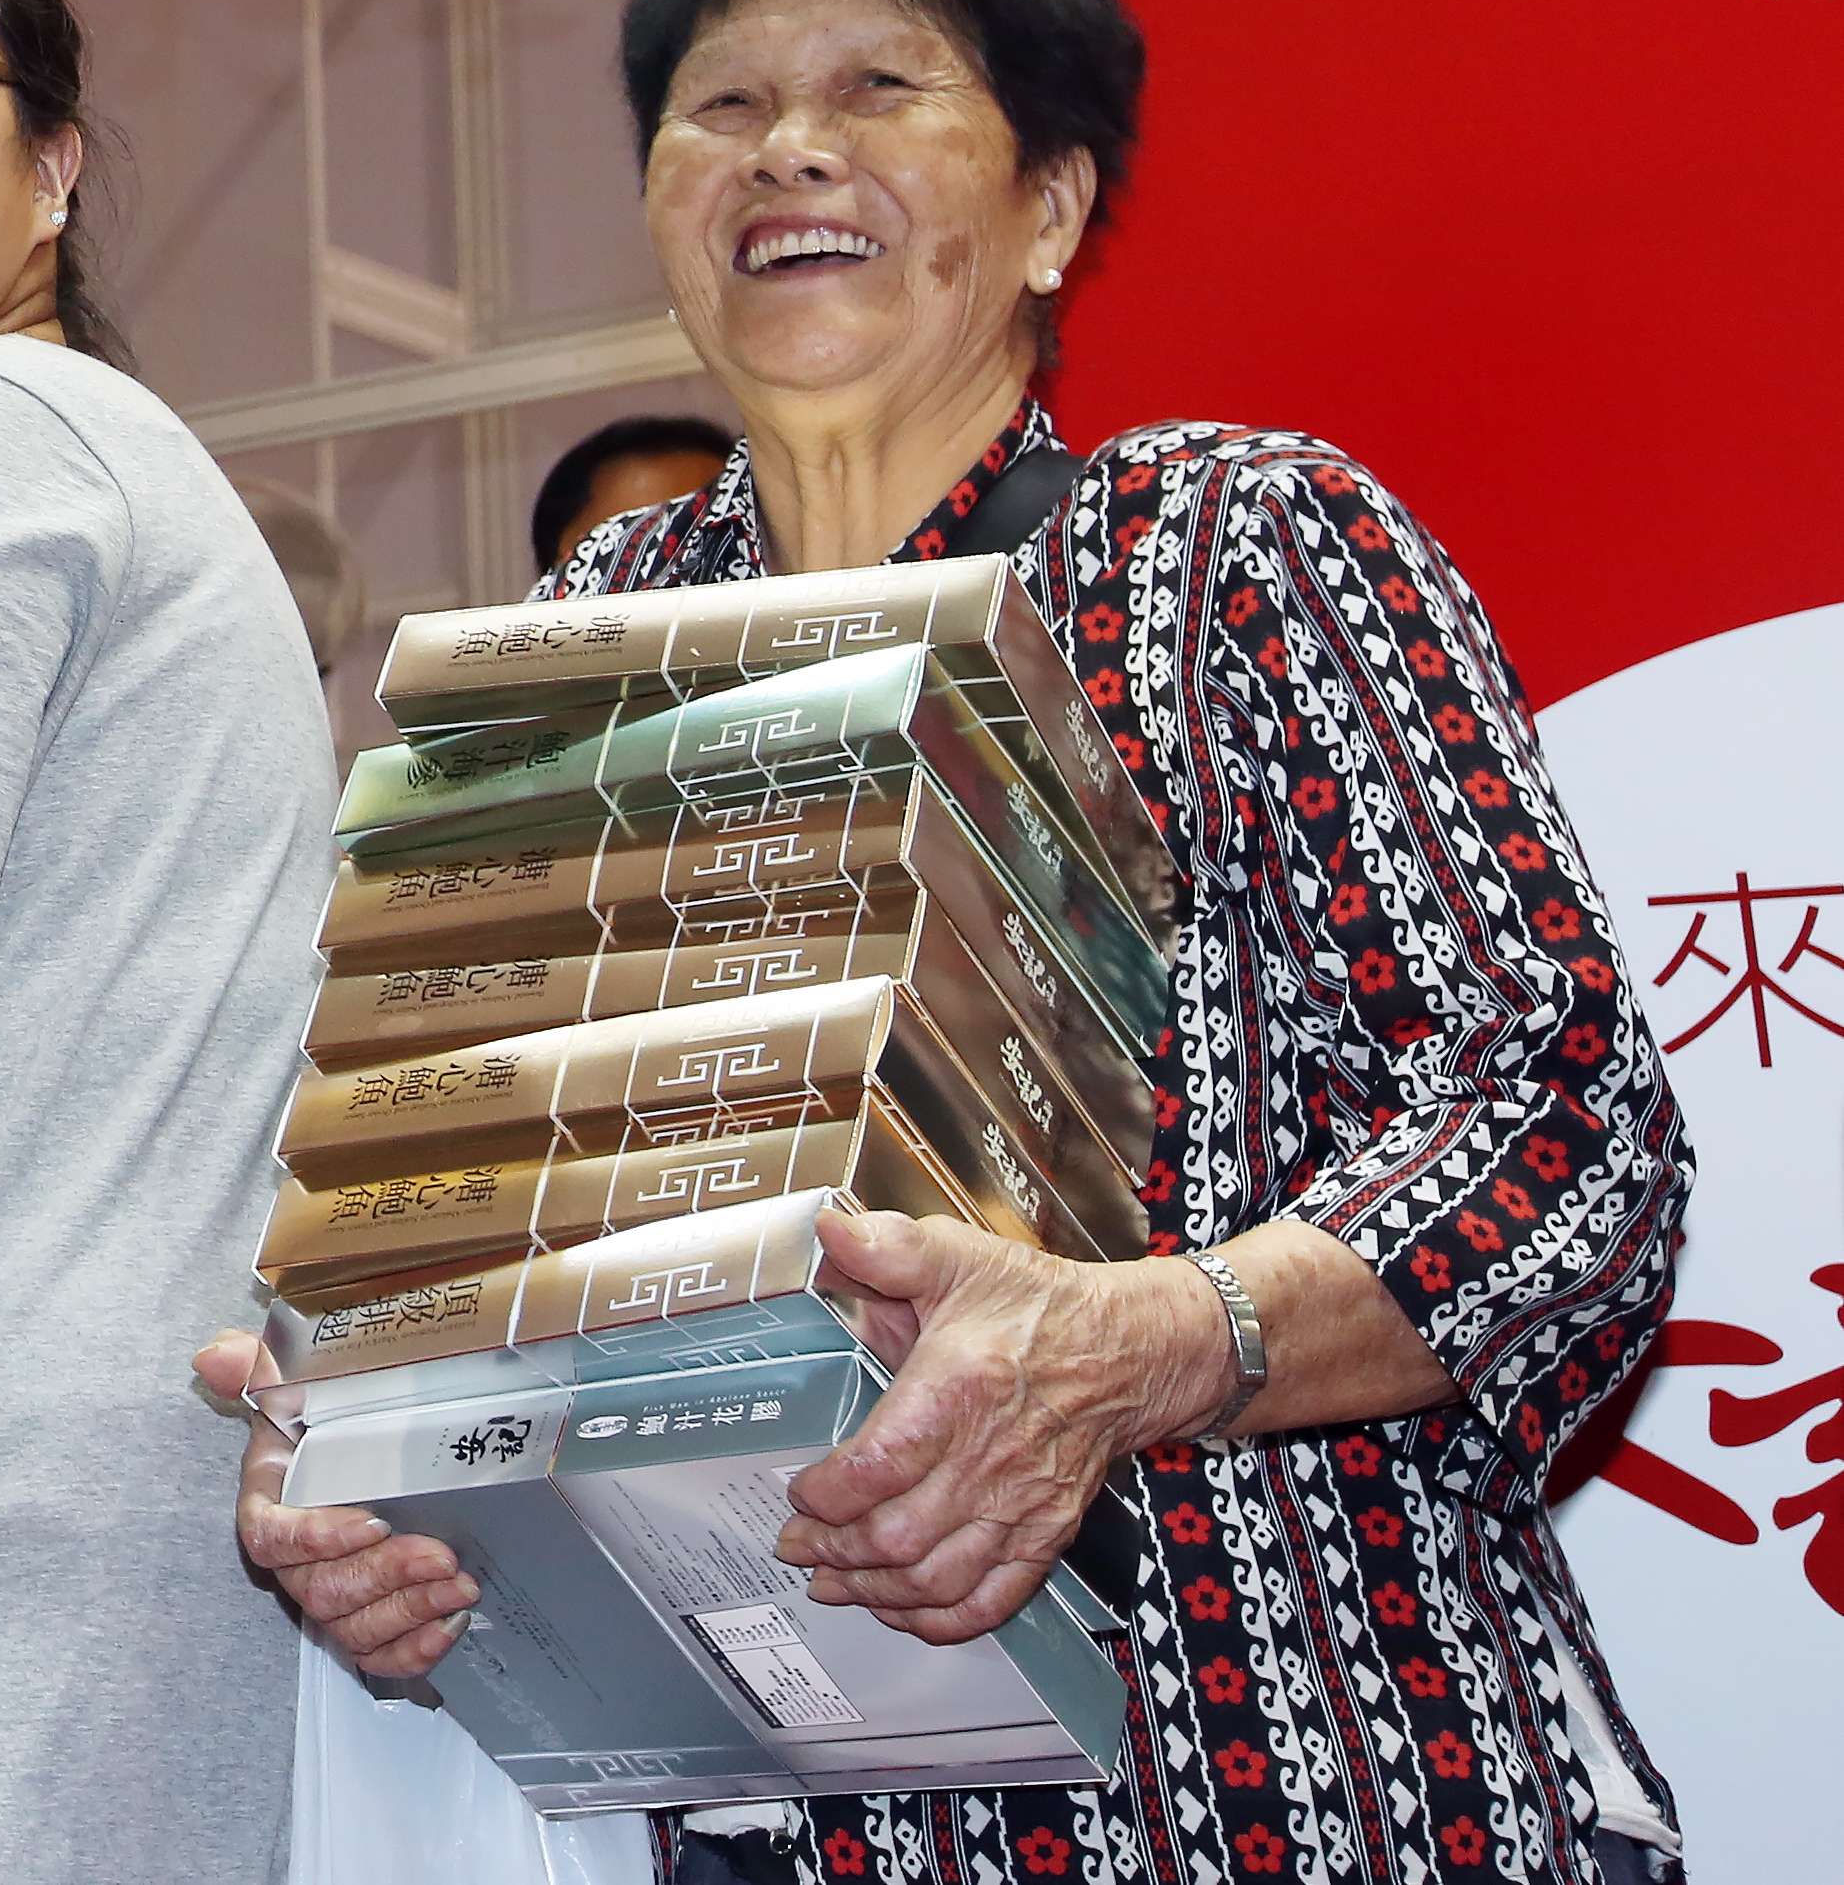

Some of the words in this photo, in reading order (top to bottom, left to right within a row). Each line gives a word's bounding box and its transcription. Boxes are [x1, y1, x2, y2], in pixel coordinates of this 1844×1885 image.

[452, 613, 630, 659] 溏心鮑魚
[388, 846, 558, 900] 溏心鮑魚
[377, 958, 552, 1006] 溏心鮑魚
[348, 1053, 521, 1110] 溏心鮑魚
[328, 1166, 503, 1224] 溏心鮑魚
[449, 1415, 533, 1466] 安記
[636, 1402, 783, 1437] 鮑汁花膠
